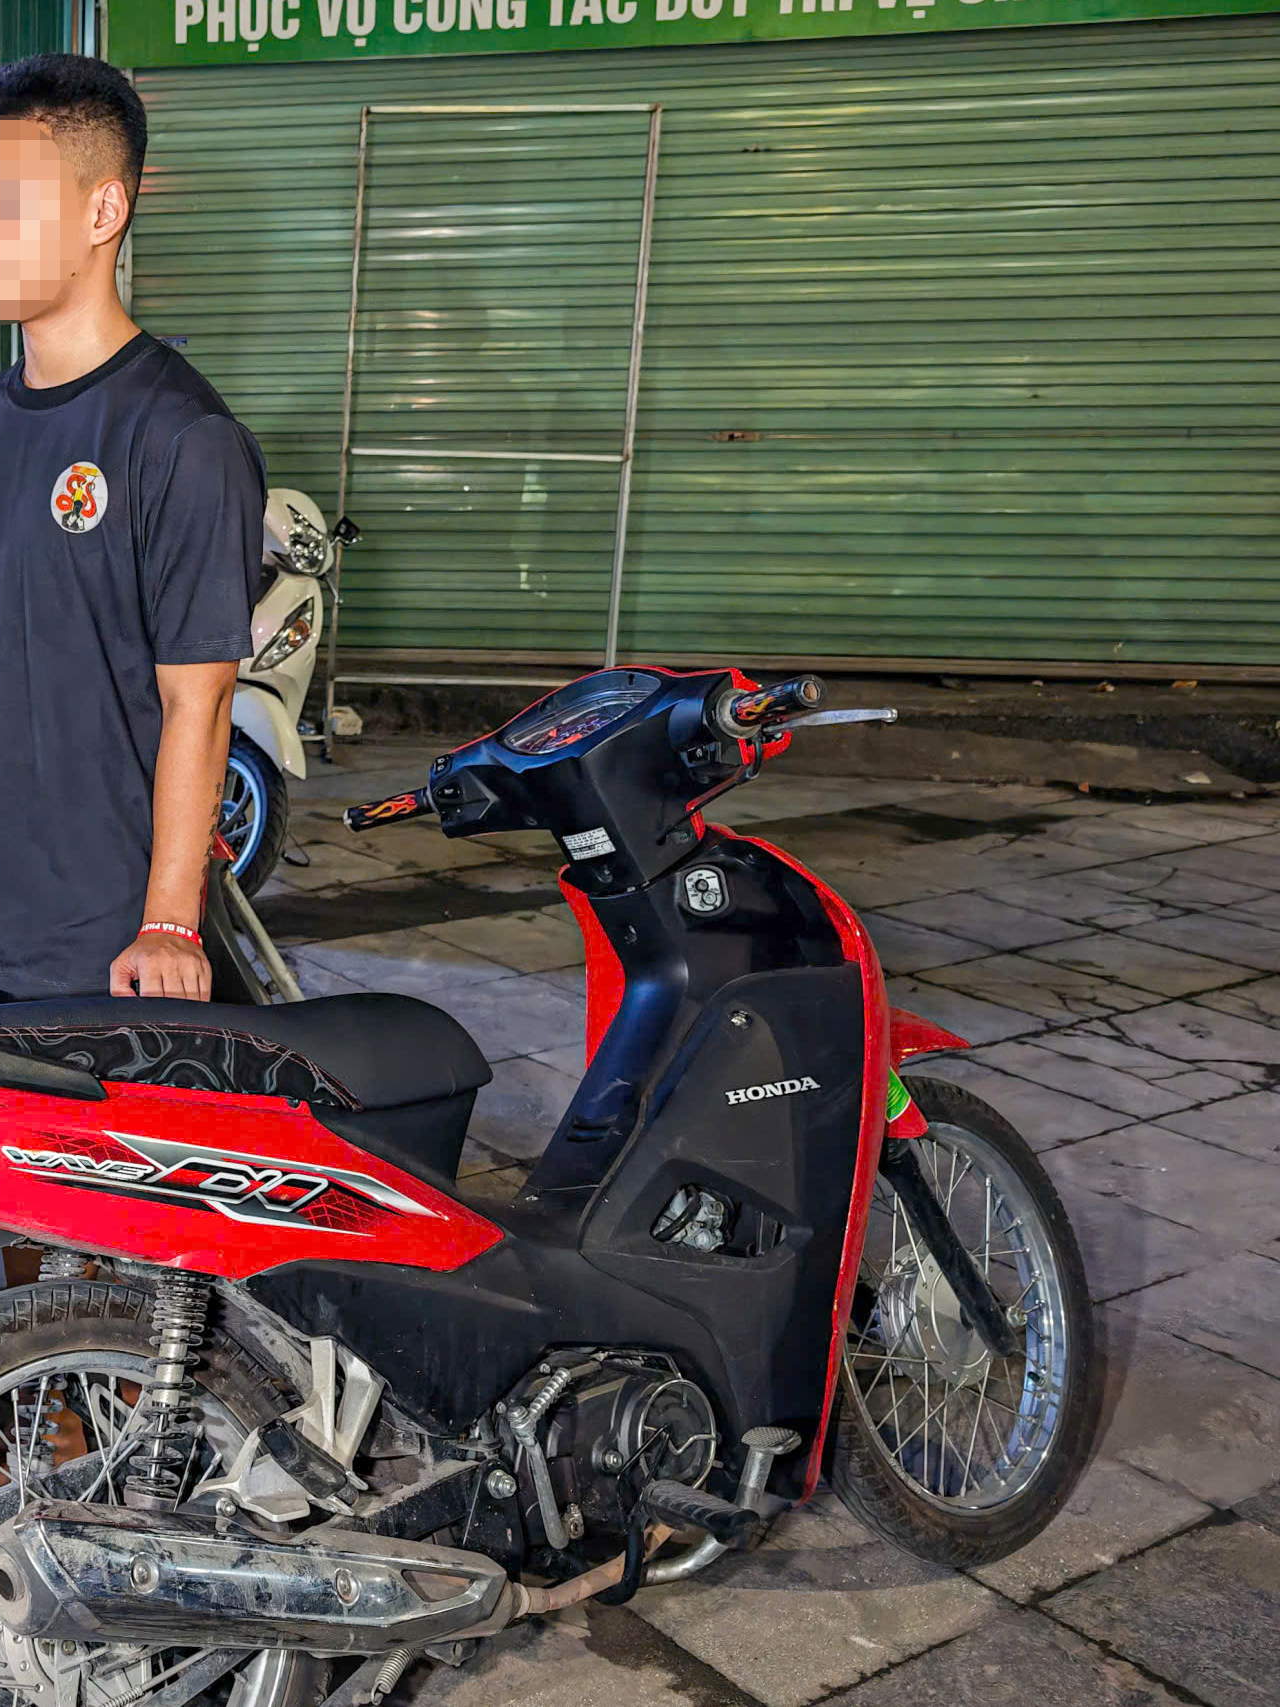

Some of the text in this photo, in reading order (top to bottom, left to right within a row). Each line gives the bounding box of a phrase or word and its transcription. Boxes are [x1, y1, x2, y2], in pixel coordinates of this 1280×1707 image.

[175, 0, 301, 52] PHỤC
[317, 0, 377, 47] VỤ
[725, 1076, 821, 1105] HONDA
